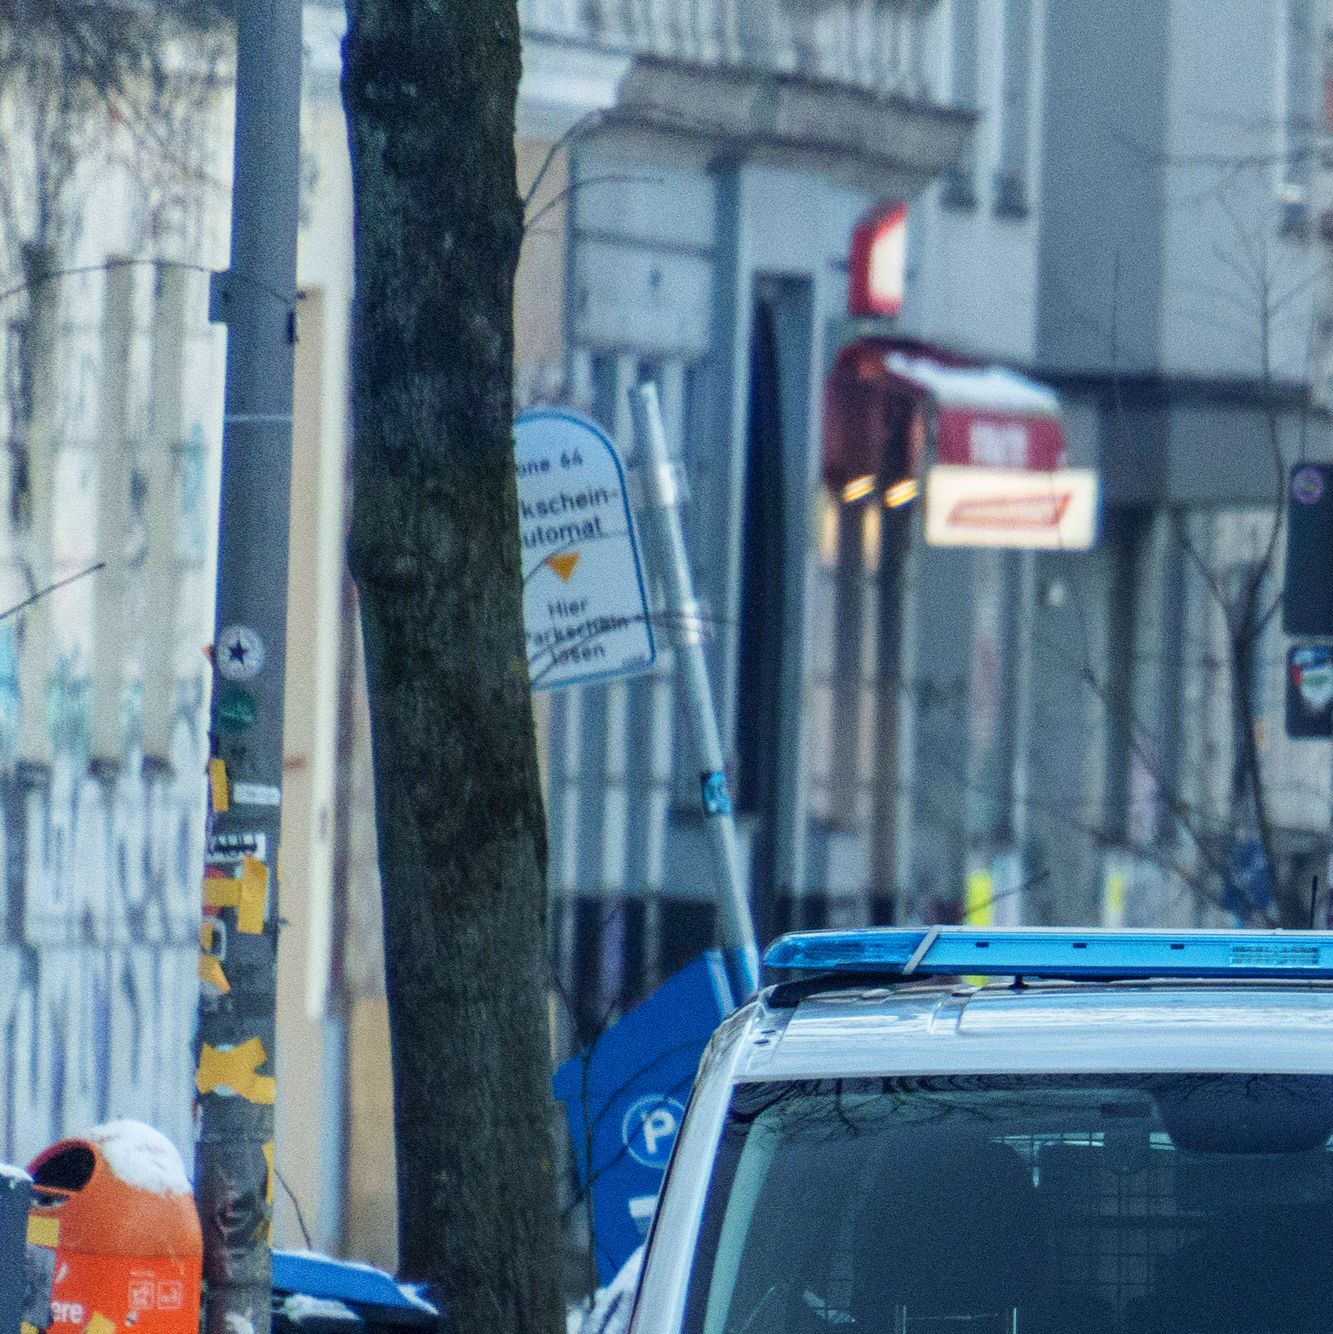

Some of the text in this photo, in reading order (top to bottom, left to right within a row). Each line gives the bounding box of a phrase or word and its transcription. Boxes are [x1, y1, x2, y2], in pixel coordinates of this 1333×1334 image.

[516, 457, 550, 480] one
[520, 486, 619, 520] kschein-
[523, 513, 603, 549] utomat
[547, 599, 588, 619] Hier
[641, 1108, 675, 1154] P
[51, 1301, 85, 1325] ere
